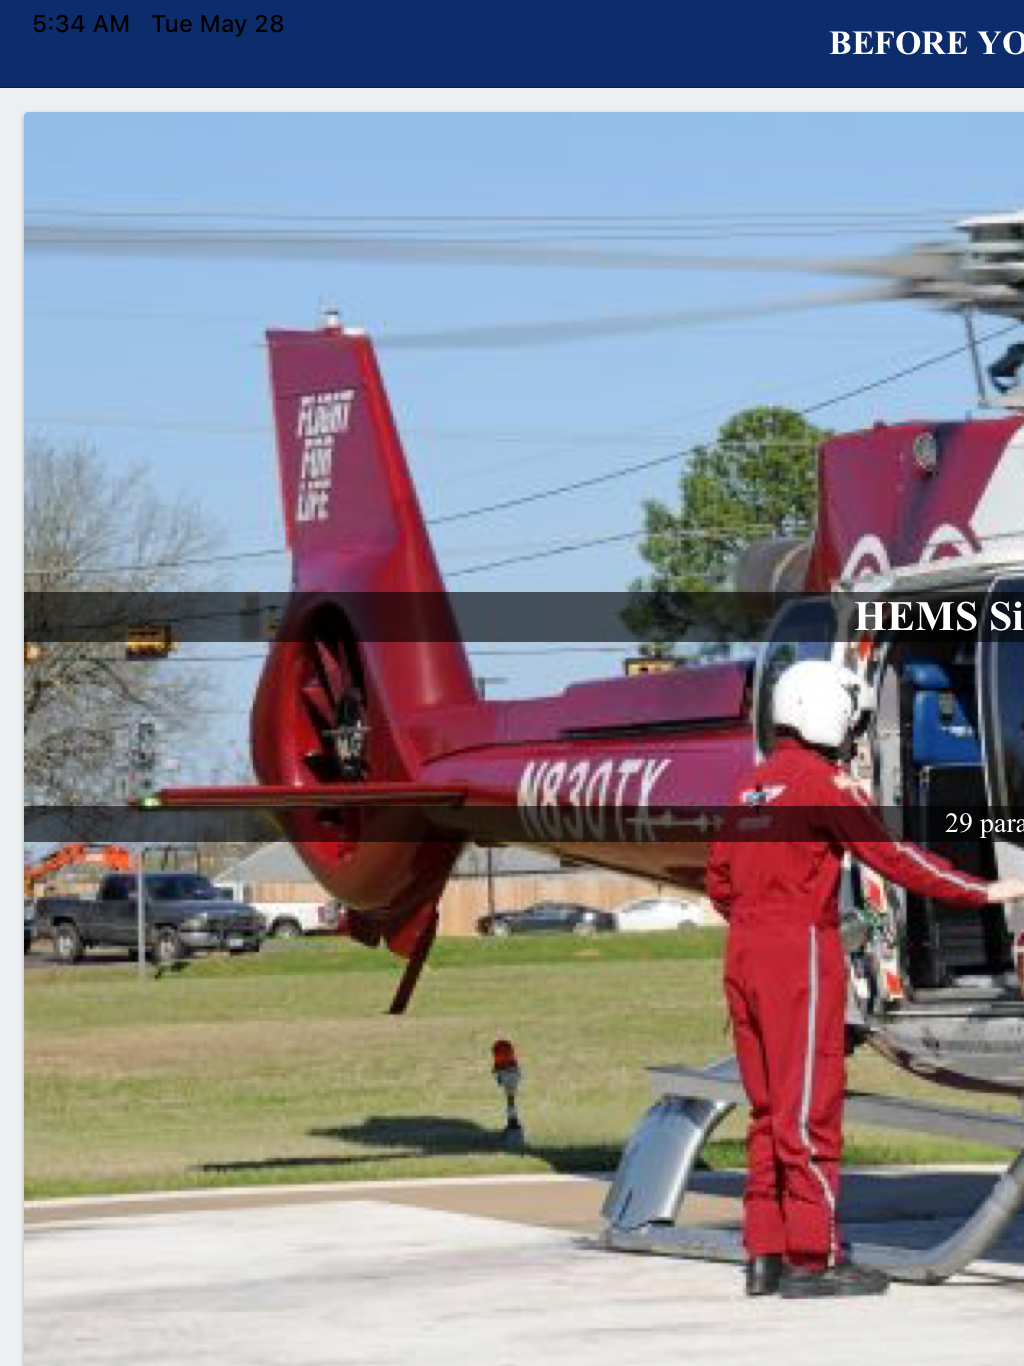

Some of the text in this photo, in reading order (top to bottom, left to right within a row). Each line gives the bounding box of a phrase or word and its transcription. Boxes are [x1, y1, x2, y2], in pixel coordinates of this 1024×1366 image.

[33, 15, 129, 32] 5:34 AM
[152, 15, 284, 37] Tue May 28
[829, 30, 967, 56] BEFORE
[517, 758, 673, 842] N830TX
